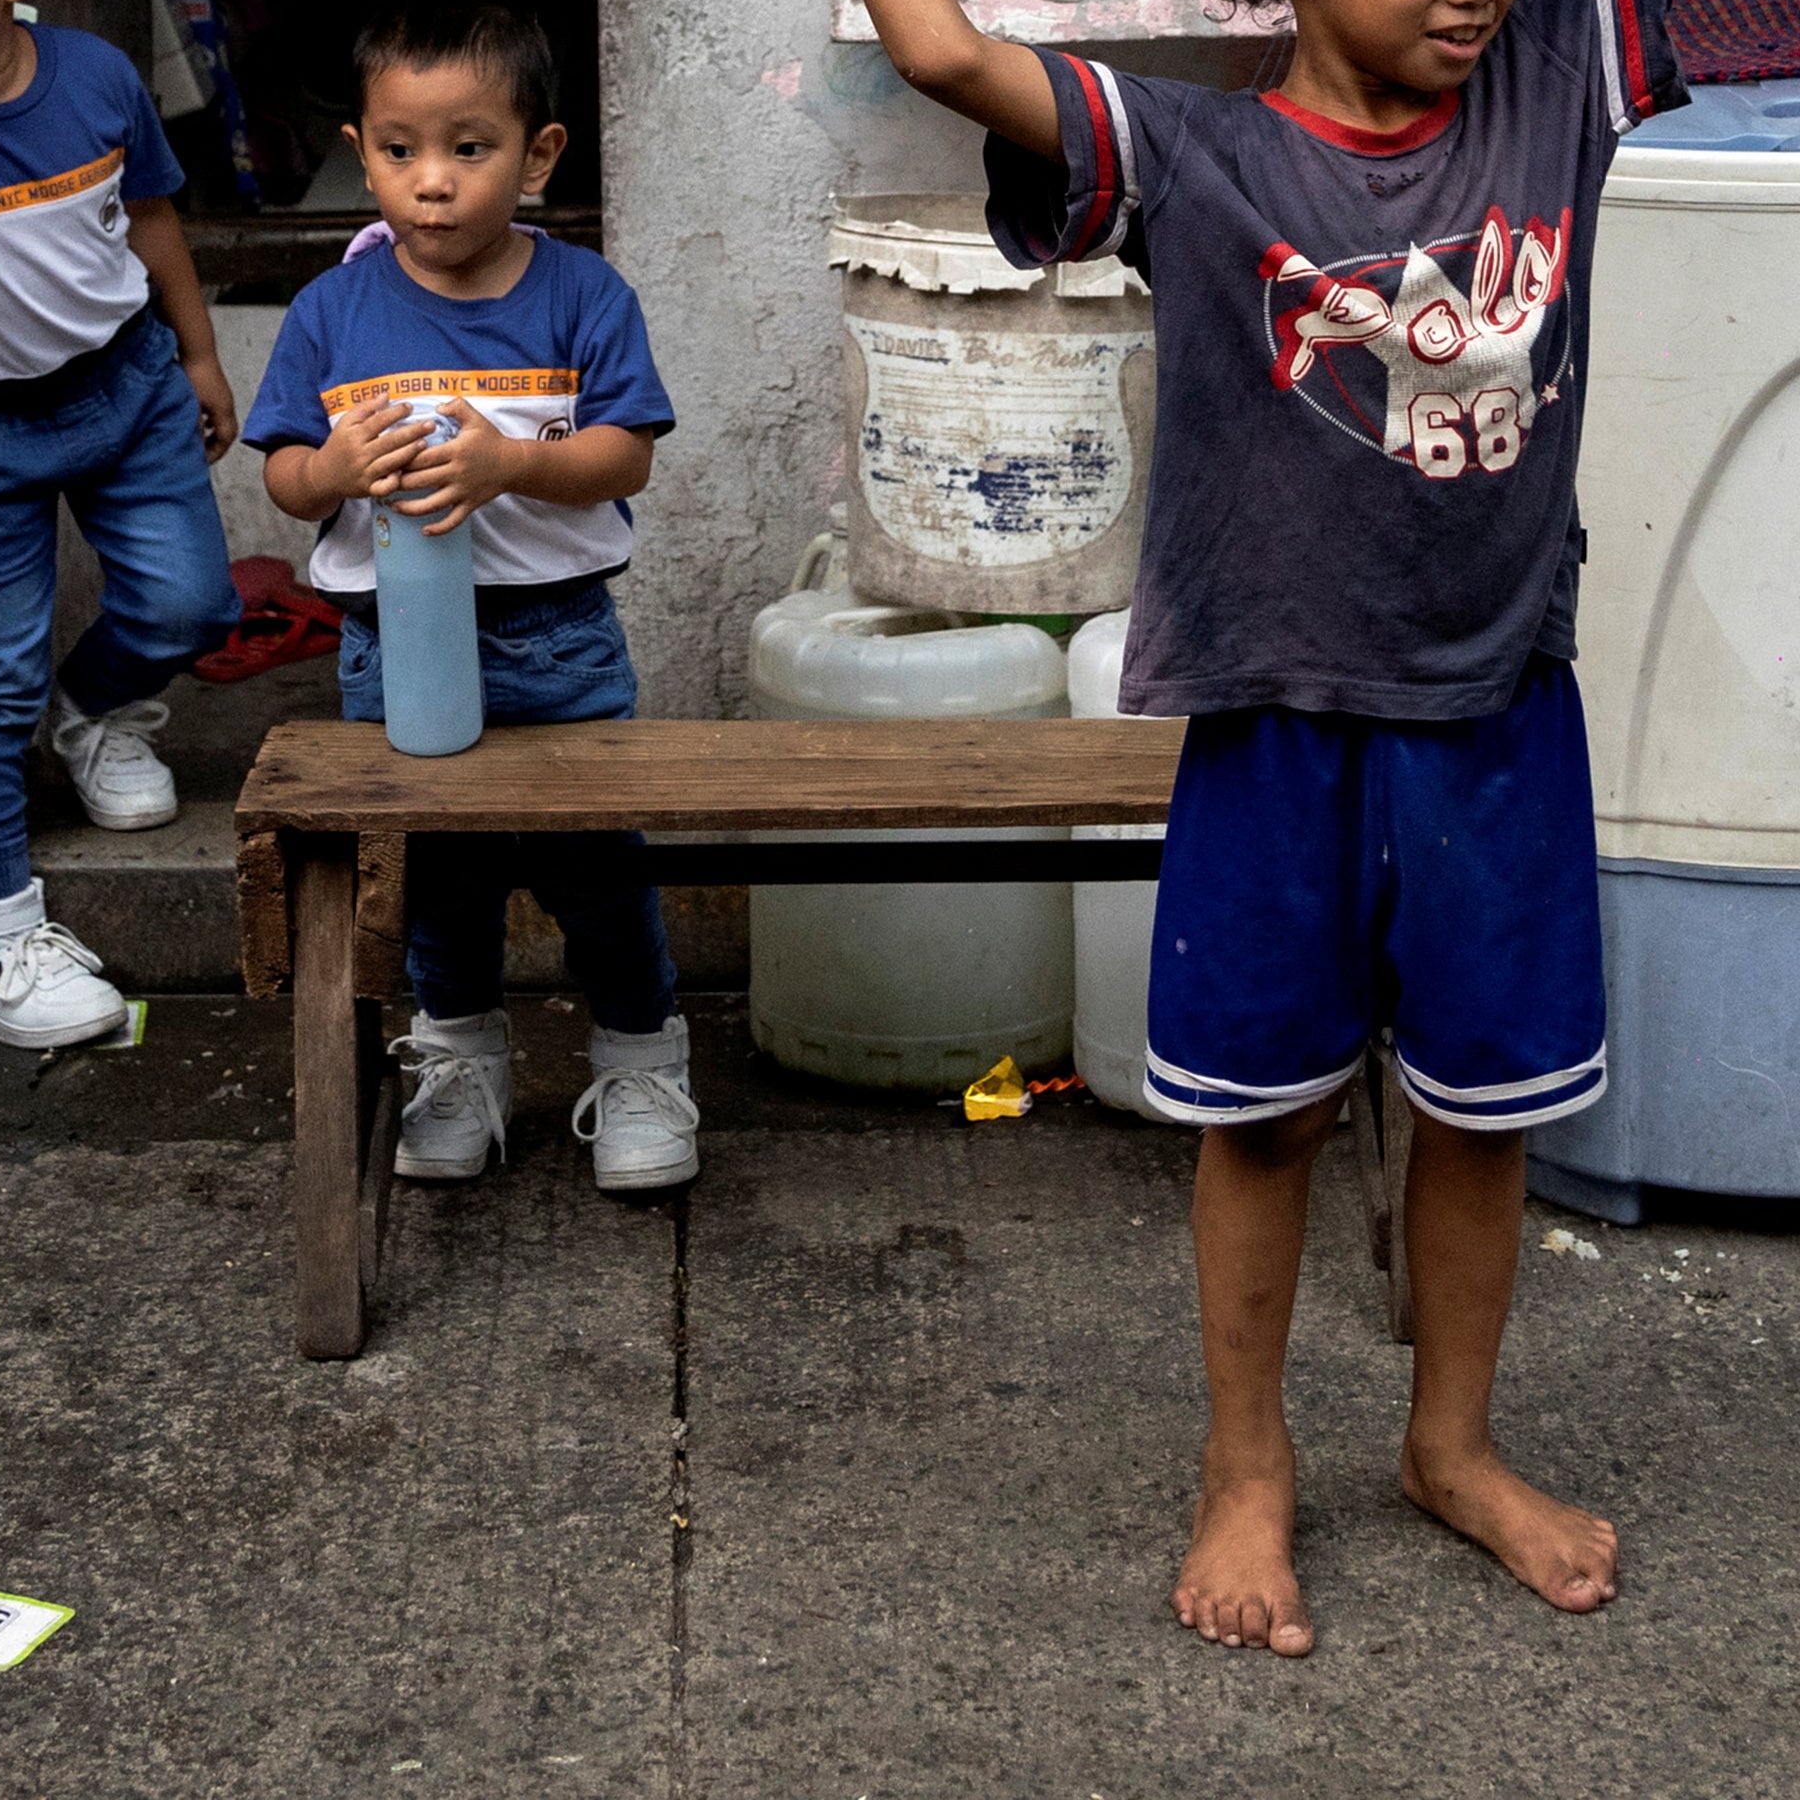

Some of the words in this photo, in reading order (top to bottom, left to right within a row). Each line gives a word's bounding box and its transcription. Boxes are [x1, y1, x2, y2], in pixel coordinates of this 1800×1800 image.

[28, 181, 76, 200] MOOSE
[395, 378, 432, 394] 1988
[438, 377, 470, 391] NYC
[476, 376, 531, 391] MOOSE
[1407, 386, 1522, 480] 68
